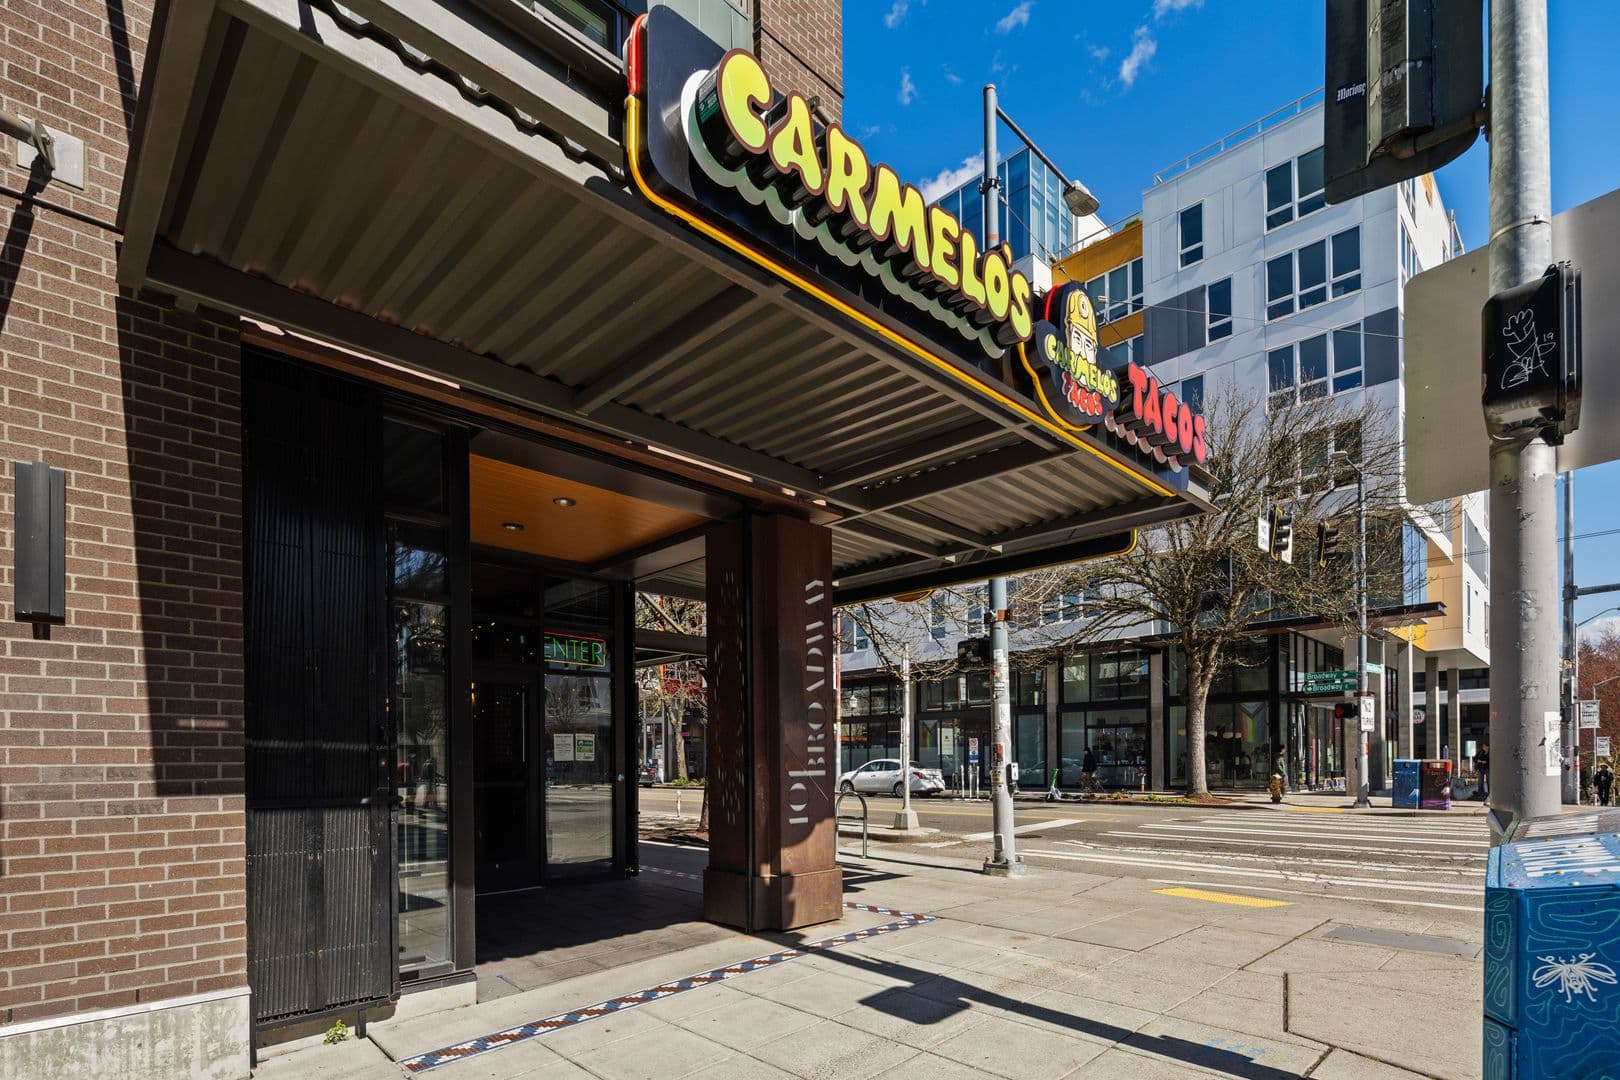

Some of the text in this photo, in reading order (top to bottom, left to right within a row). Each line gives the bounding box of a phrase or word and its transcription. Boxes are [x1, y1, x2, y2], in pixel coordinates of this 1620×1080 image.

[717, 48, 1033, 342] CARMELO'S
[1044, 333, 1118, 404] CARMELO'S
[1061, 370, 1103, 417] TACOS
[1127, 360, 1208, 464] TACOS
[544, 635, 603, 664] ENTER
[1306, 672, 1338, 680] Broadway
[1313, 683, 1343, 692] Broadway
